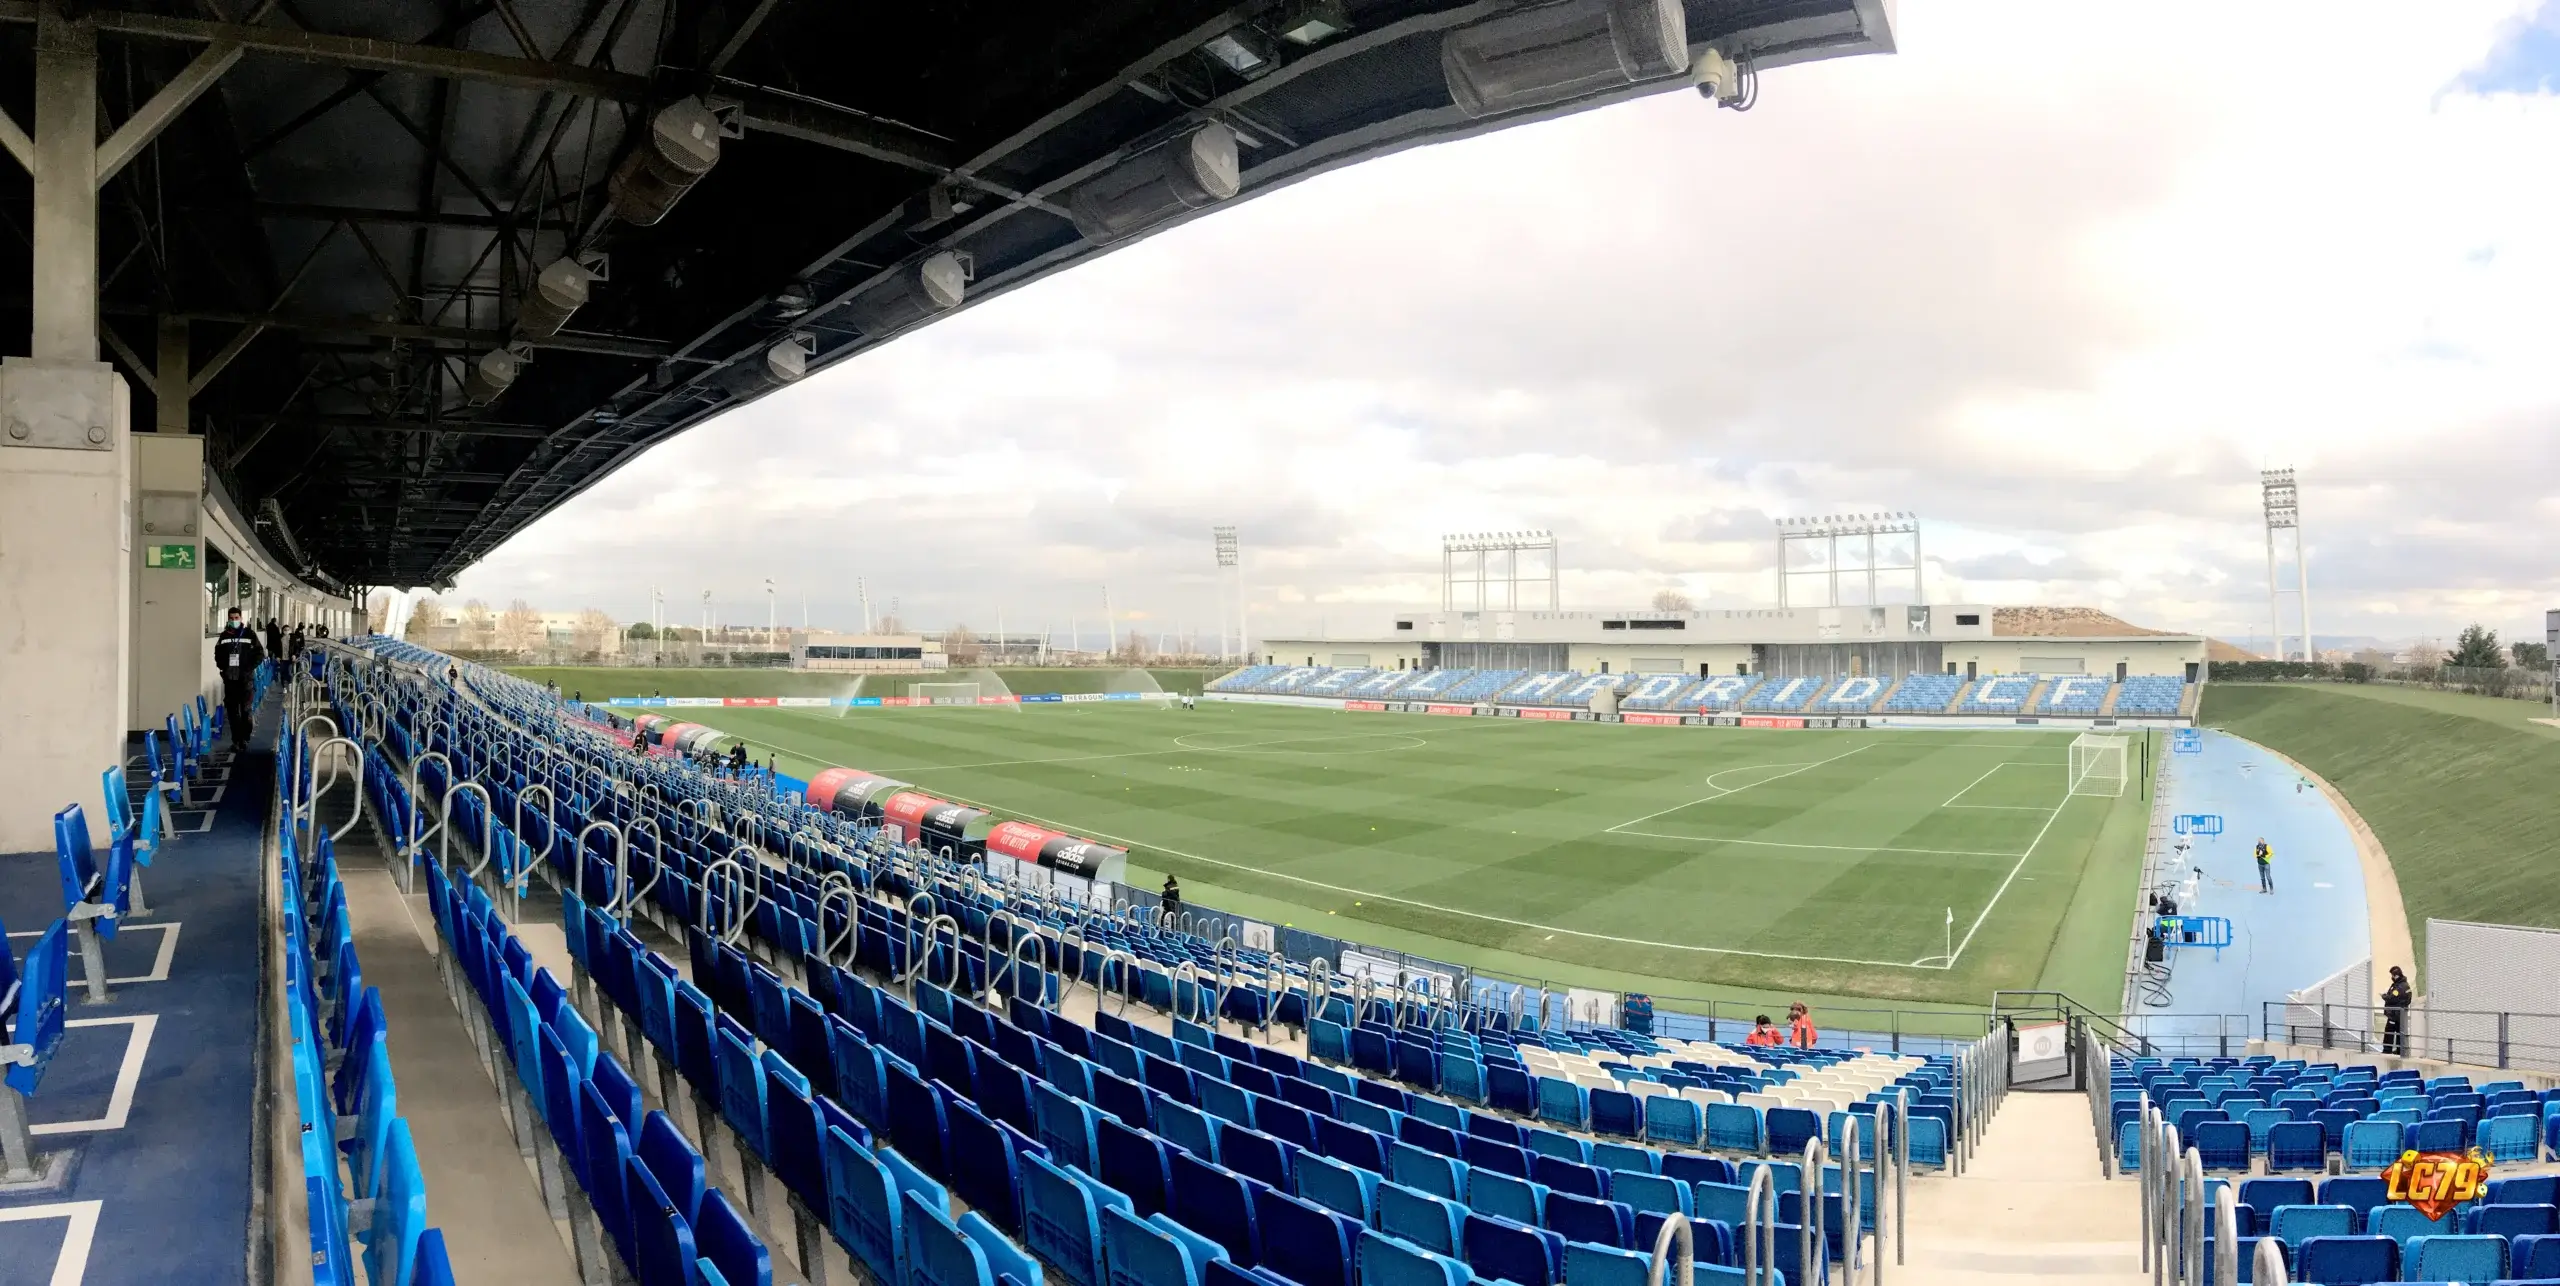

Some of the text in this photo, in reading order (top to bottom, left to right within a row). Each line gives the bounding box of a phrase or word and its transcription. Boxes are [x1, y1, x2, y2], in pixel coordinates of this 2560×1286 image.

[1269, 667, 1443, 692] REAL
[1511, 672, 1880, 704] MADRID
[1743, 718, 1773, 727] Emirates
[1002, 824, 1042, 840] Emirates
[1057, 849, 1085, 864] adidas
